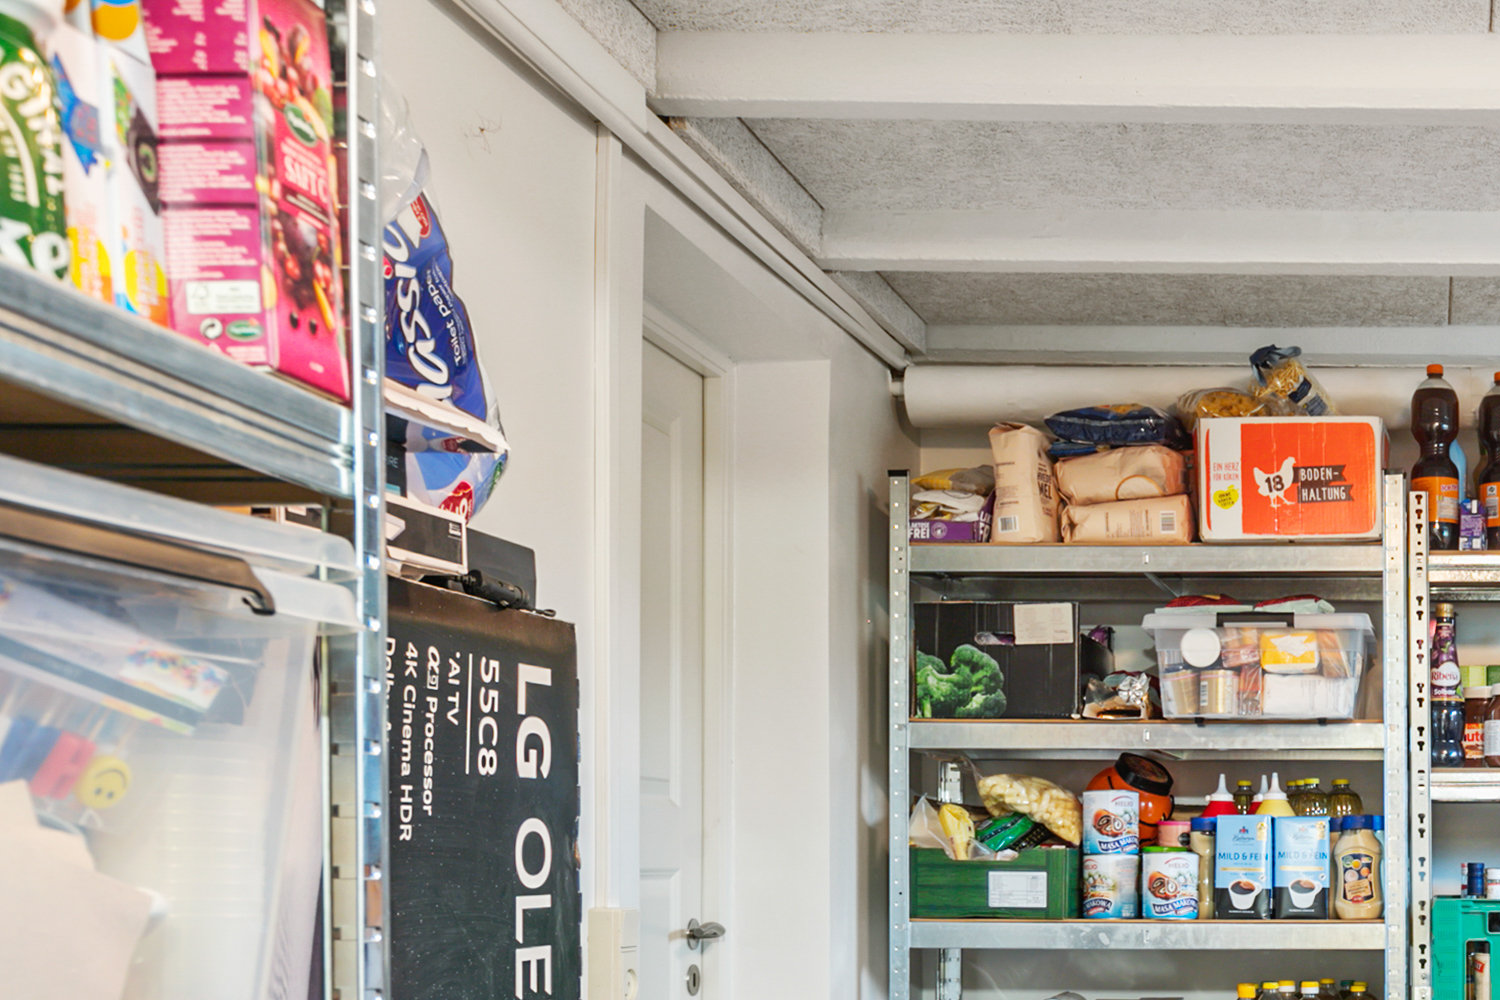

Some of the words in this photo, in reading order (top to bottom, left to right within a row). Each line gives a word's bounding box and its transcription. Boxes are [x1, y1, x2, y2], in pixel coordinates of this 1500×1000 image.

[446, 319, 462, 366] Toilet
[1264, 475, 1285, 493] 18
[1300, 467, 1339, 481] BODEN-
[1301, 487, 1346, 501] HALTUNG
[404, 641, 419, 678] 4K
[1431, 670, 1458, 681] Ribena
[447, 691, 460, 726] TV
[477, 656, 500, 776] 55C8
[516, 663, 552, 779] LG
[400, 684, 417, 777] Cinema
[422, 696, 438, 816] Processor
[399, 784, 414, 842] HDR
[1218, 852, 1239, 861] MILD
[1250, 852, 1268, 861] FEIN
[1278, 851, 1299, 860] MILD
[1309, 851, 1328, 860] FEIN
